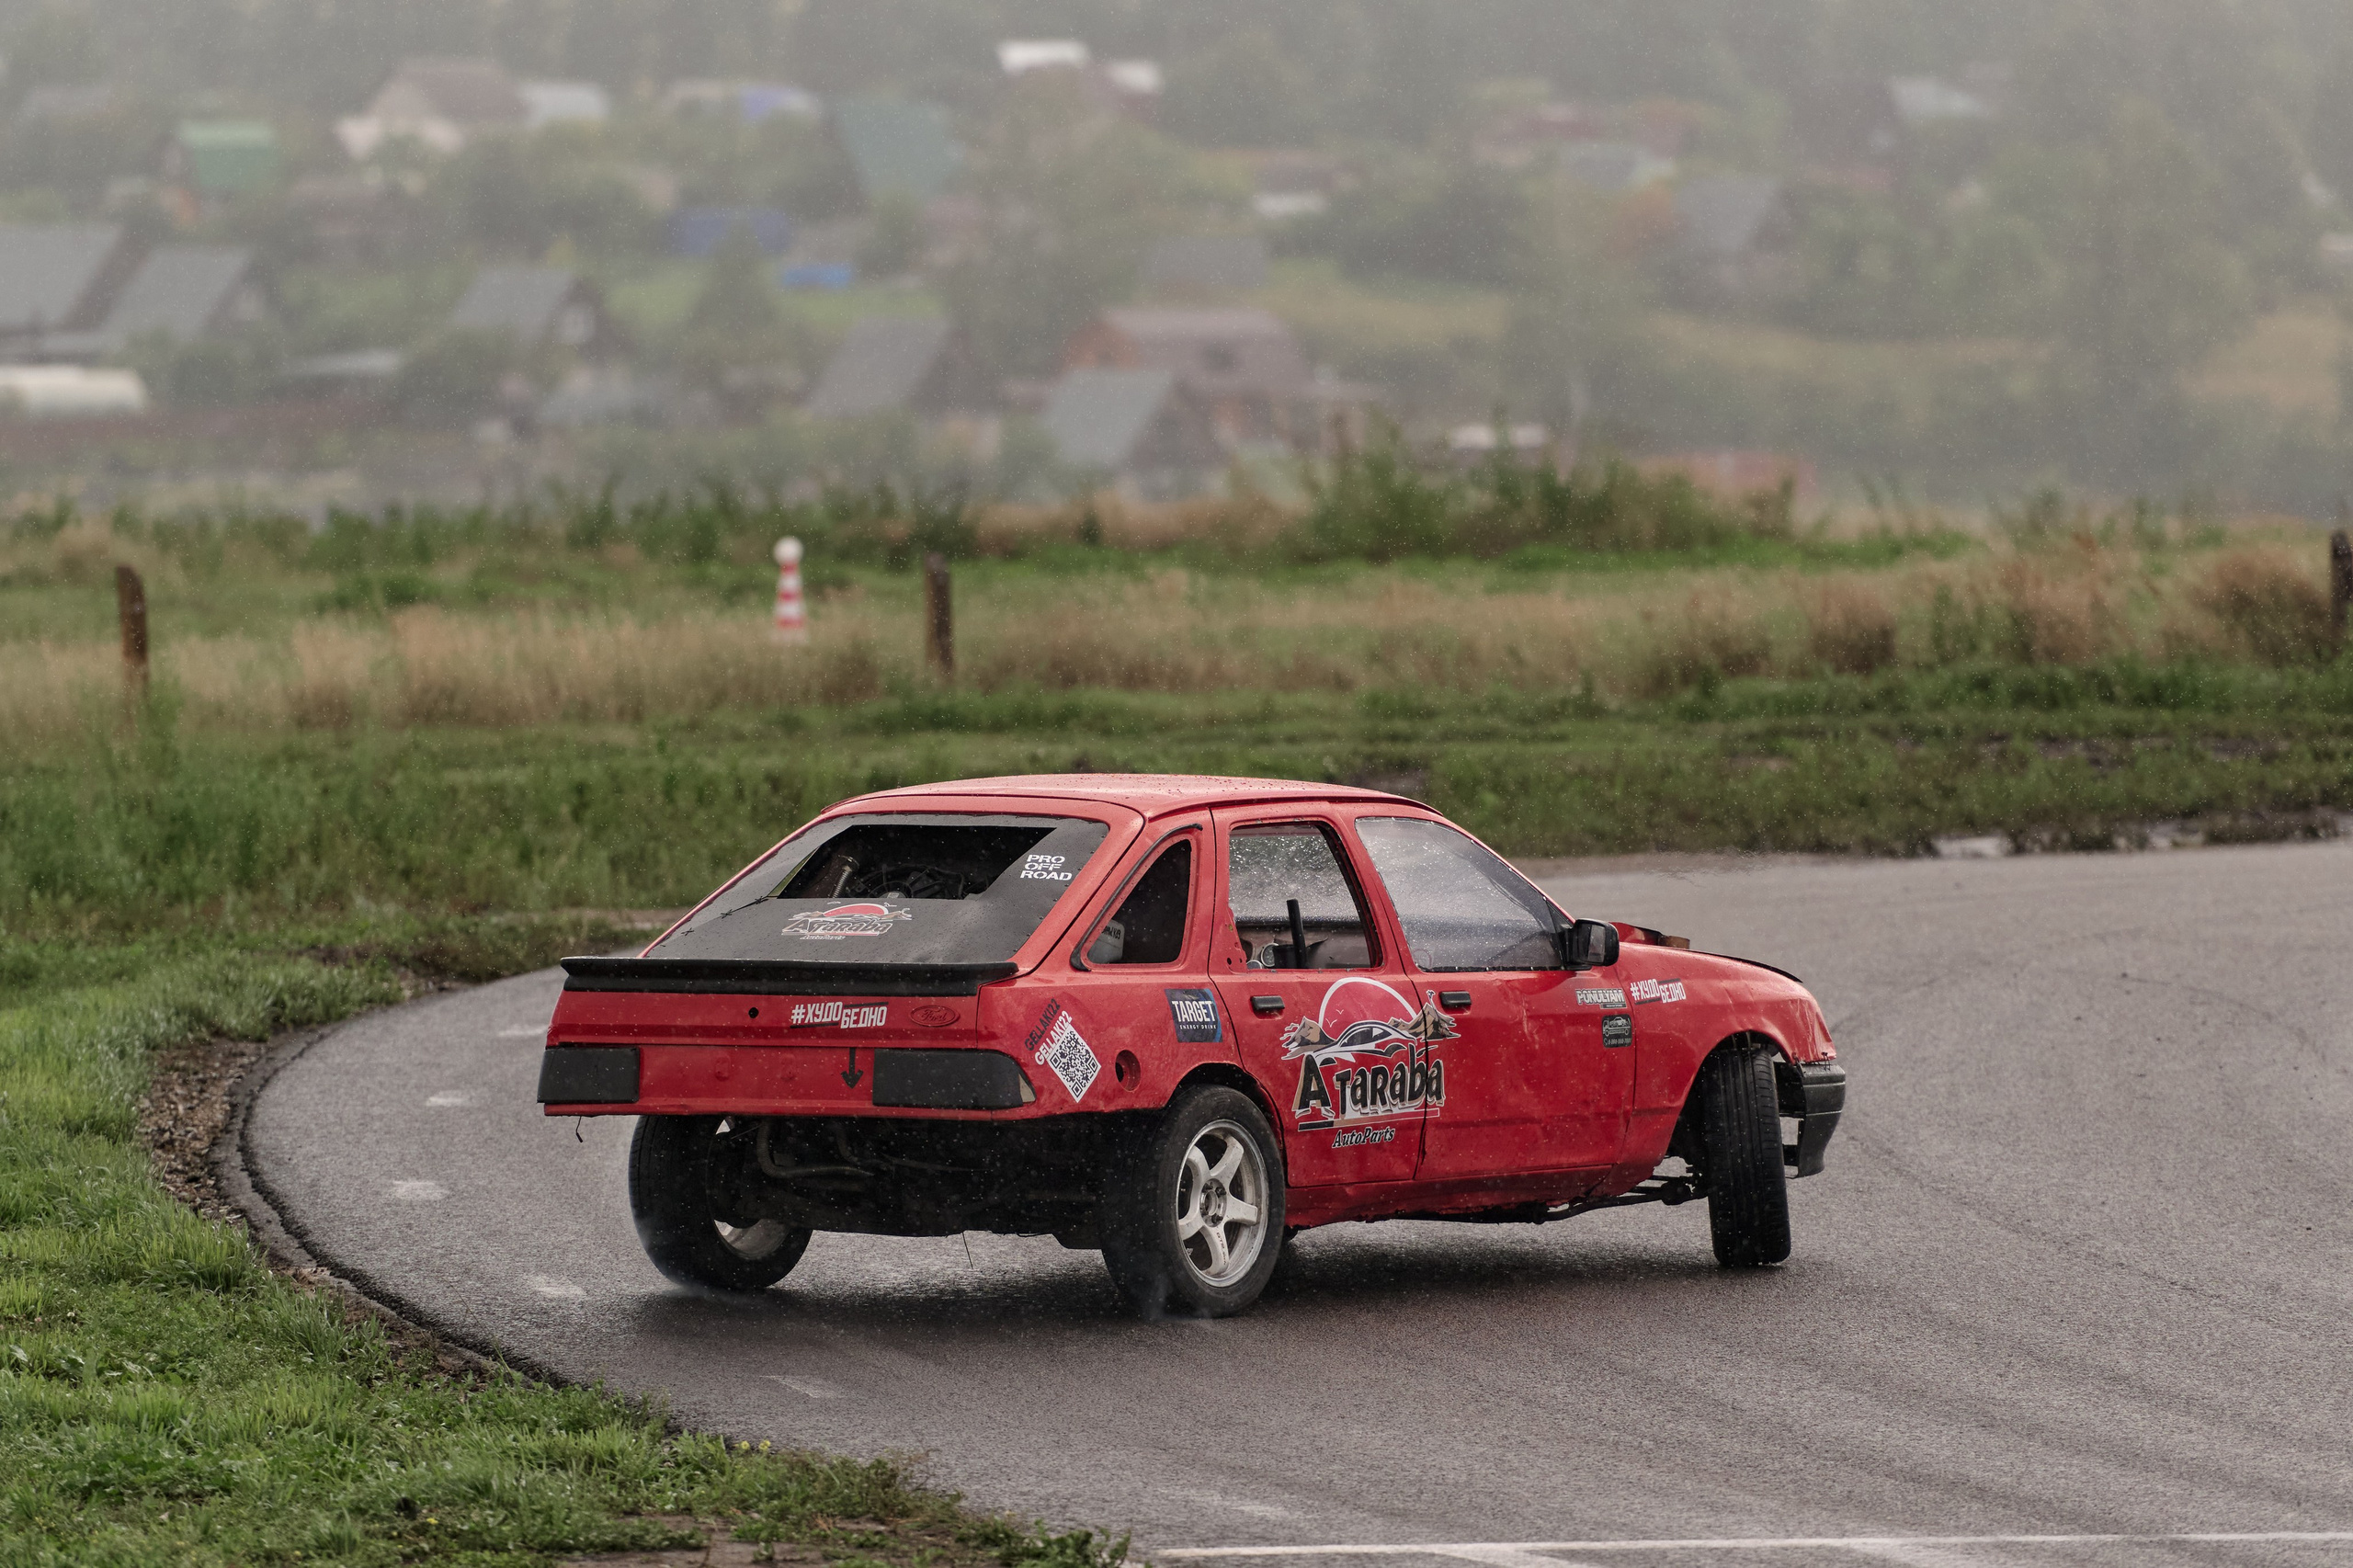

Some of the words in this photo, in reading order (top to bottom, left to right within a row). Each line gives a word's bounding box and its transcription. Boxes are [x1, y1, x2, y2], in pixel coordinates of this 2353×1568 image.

[1024, 863, 1063, 871] OFF
[1027, 855, 1065, 864] PRO
[1020, 870, 1073, 881] ROAD
[1575, 989, 1626, 1005] PONULYAM
[1171, 1000, 1216, 1022] TARGET
[1025, 998, 1061, 1051] GELLAKI22
[1035, 1010, 1073, 1065] GELLAKI22
[1332, 1126, 1395, 1148] AutoParts
